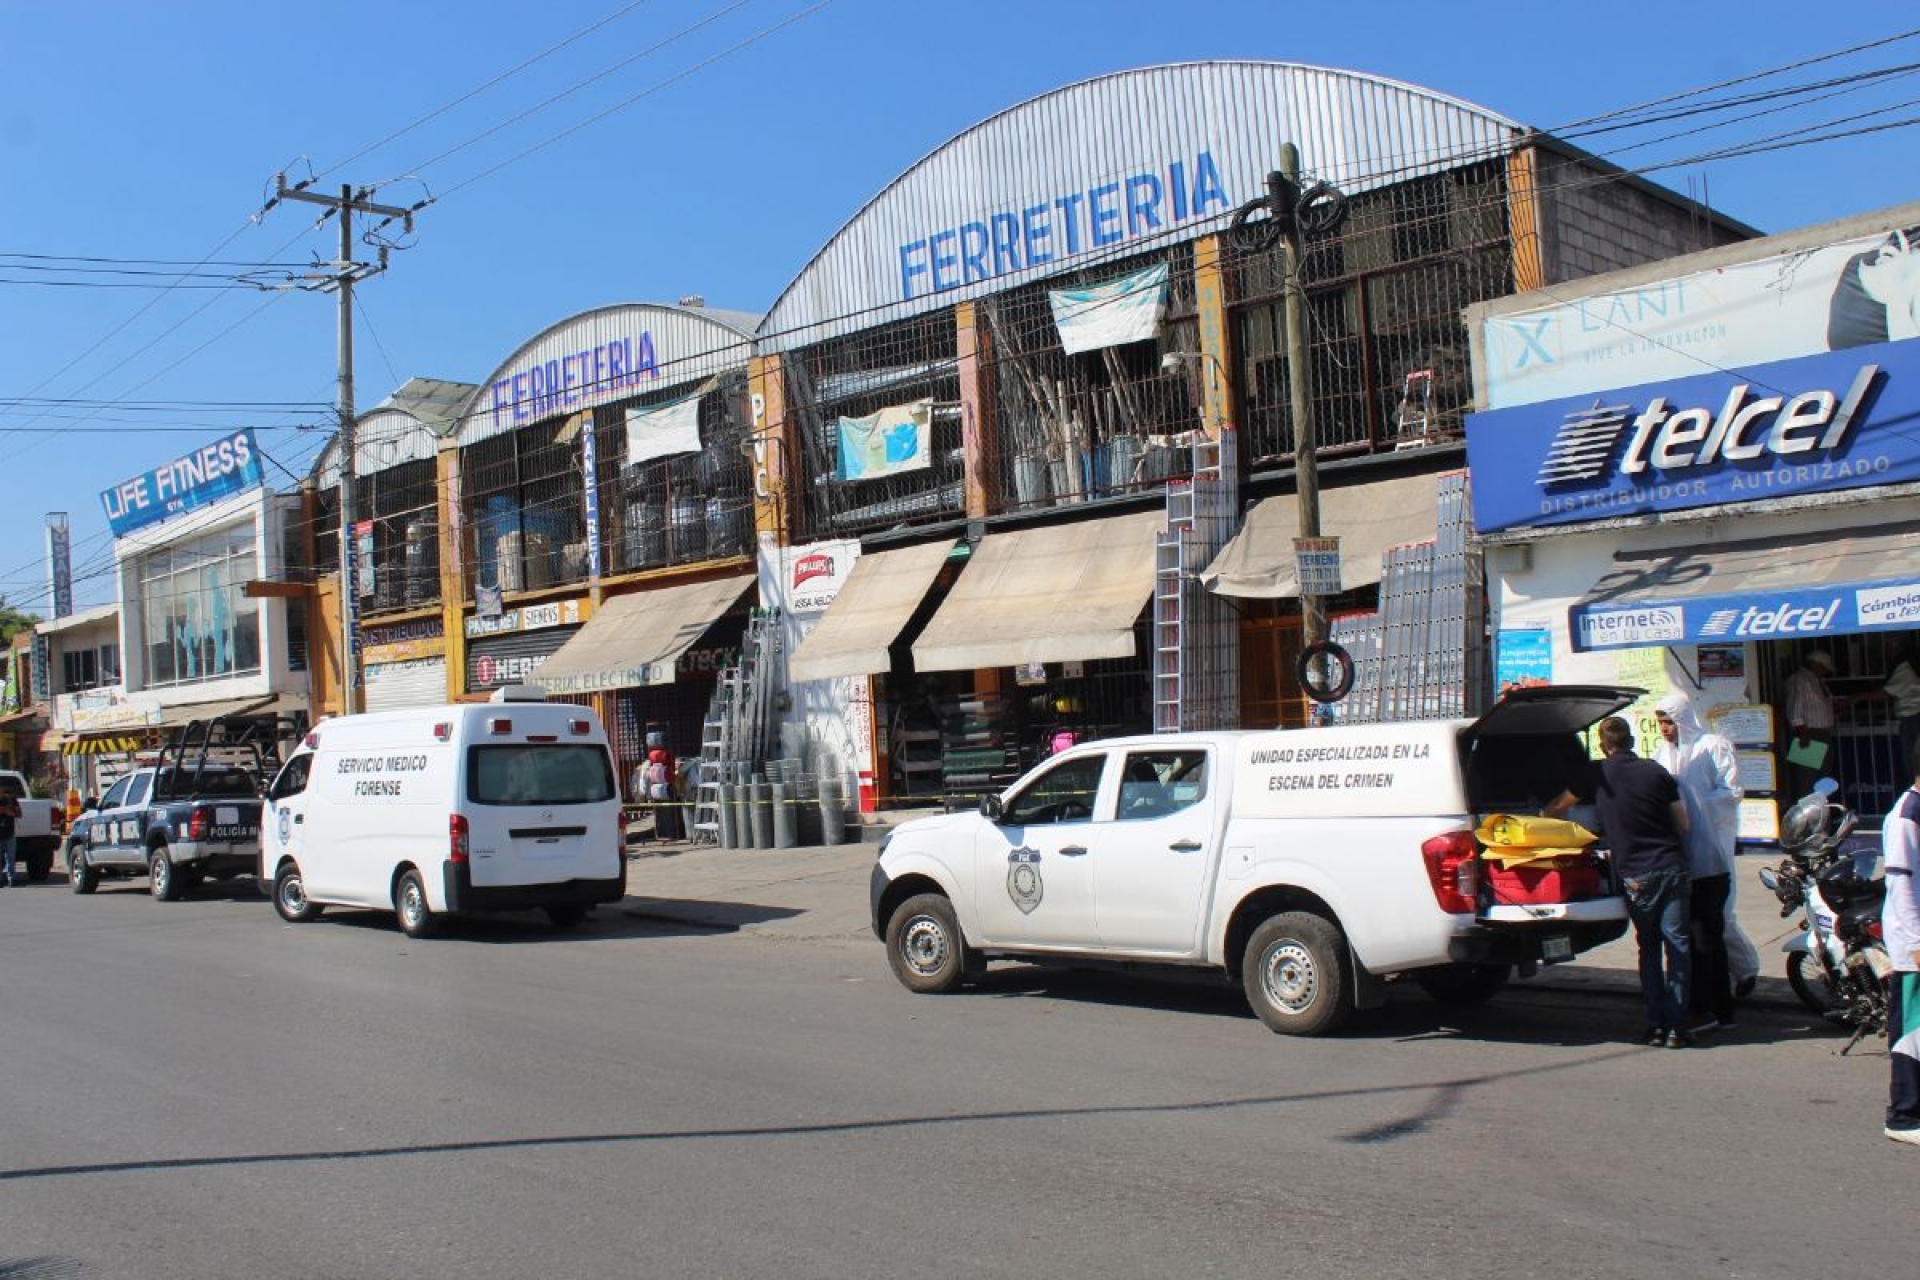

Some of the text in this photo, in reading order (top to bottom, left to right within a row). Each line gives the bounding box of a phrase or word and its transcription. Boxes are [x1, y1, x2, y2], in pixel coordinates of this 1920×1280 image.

[899, 151, 1229, 300] FERRETERIA
[491, 331, 661, 428] FERRETERIA
[1621, 364, 1880, 474] telcel
[103, 434, 250, 520] LIFE FITNESS
[1540, 454, 1891, 515] DISTRIBUIDOR AUTORIZADO
[1582, 612, 1656, 632] Internet
[1736, 598, 1841, 636] telcel
[1600, 631, 1617, 642] en
[1624, 629, 1638, 640] tu
[338, 755, 427, 773] SERVICIO MEDICO
[1251, 743, 1430, 764] UNIDAD ESPECIALIZADA EN LA
[355, 780, 402, 796] FORENSE
[1269, 773, 1394, 791] ESCENA DEL CRIMEN
